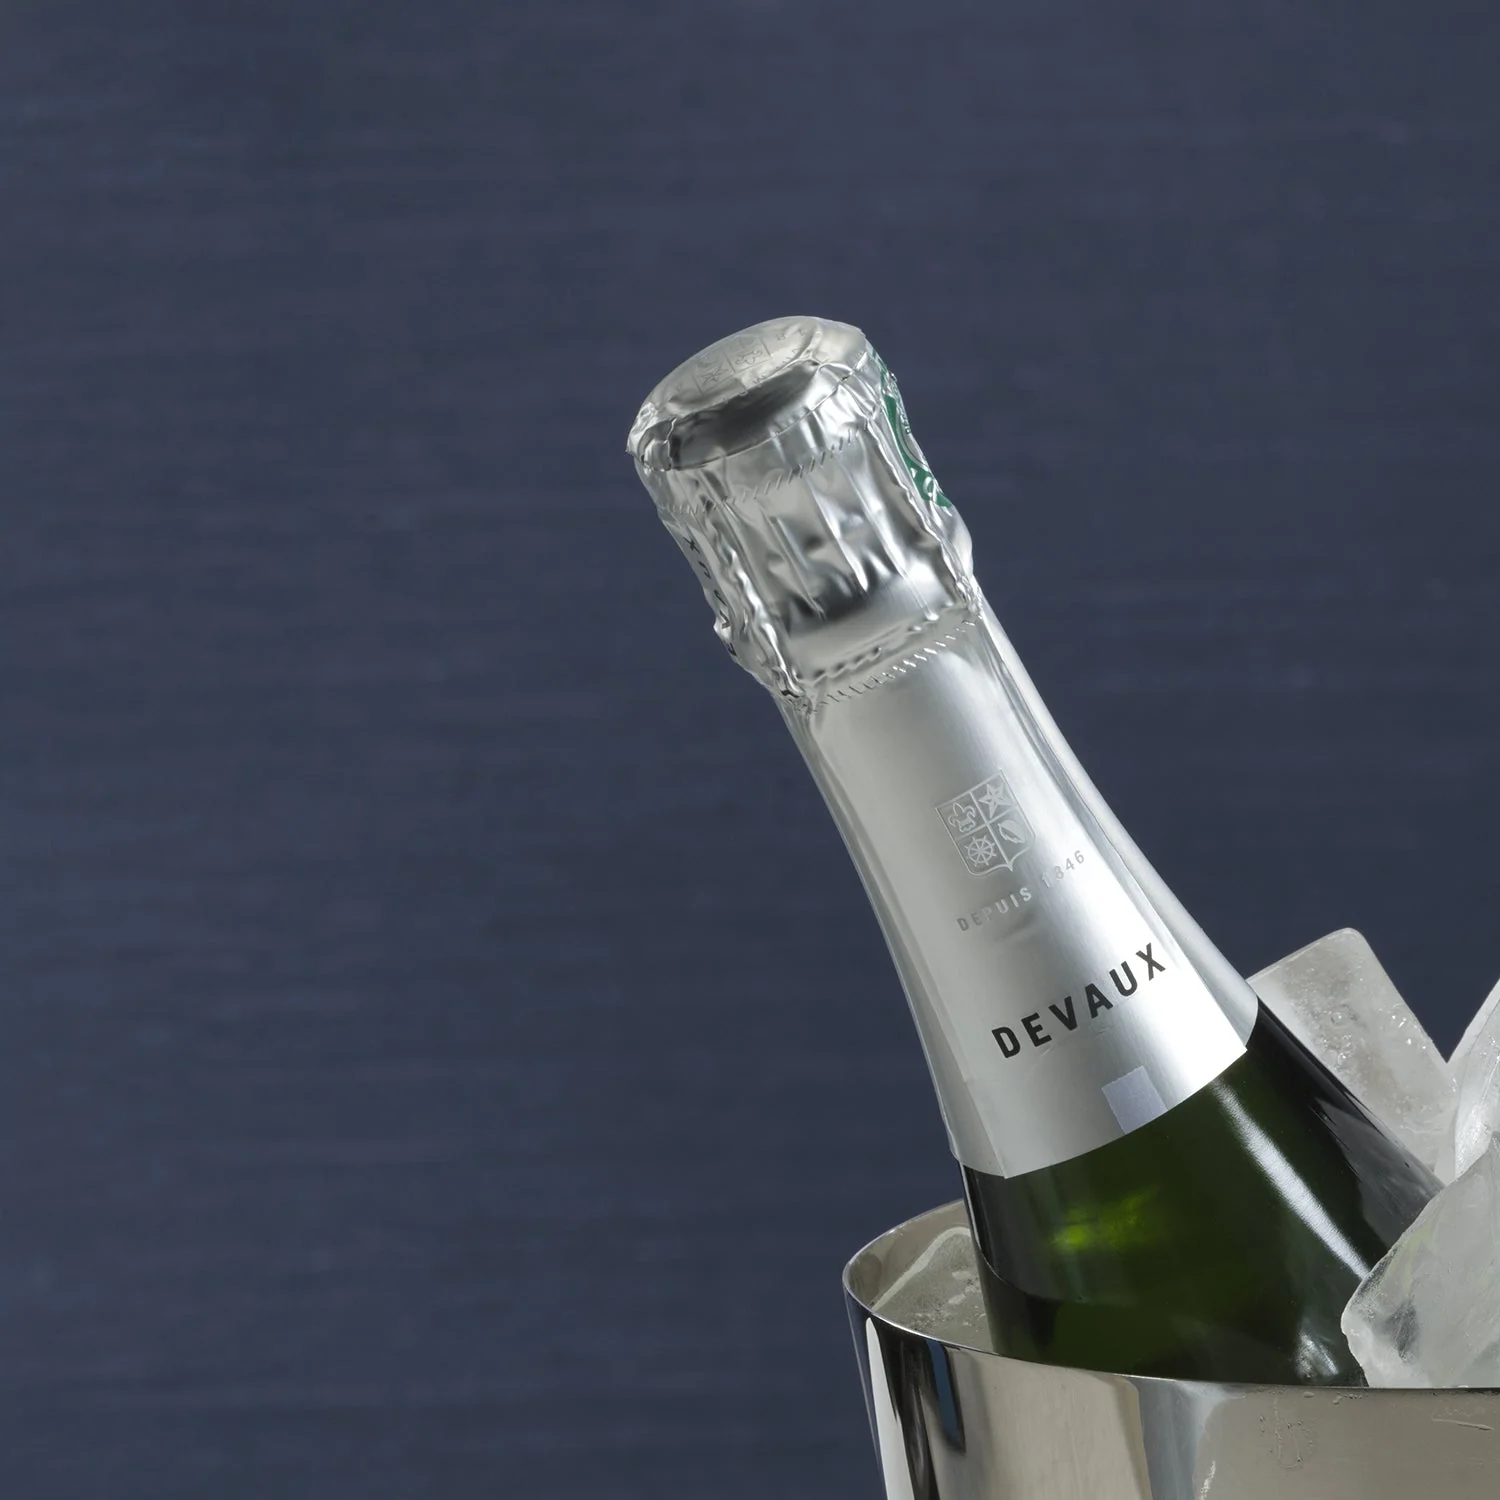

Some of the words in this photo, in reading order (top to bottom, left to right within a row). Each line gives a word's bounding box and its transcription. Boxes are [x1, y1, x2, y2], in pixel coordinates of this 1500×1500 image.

[956, 887, 1032, 931] DEPUIS
[1040, 850, 1085, 888] 1846
[991, 942, 1166, 1059] DEVAUX
